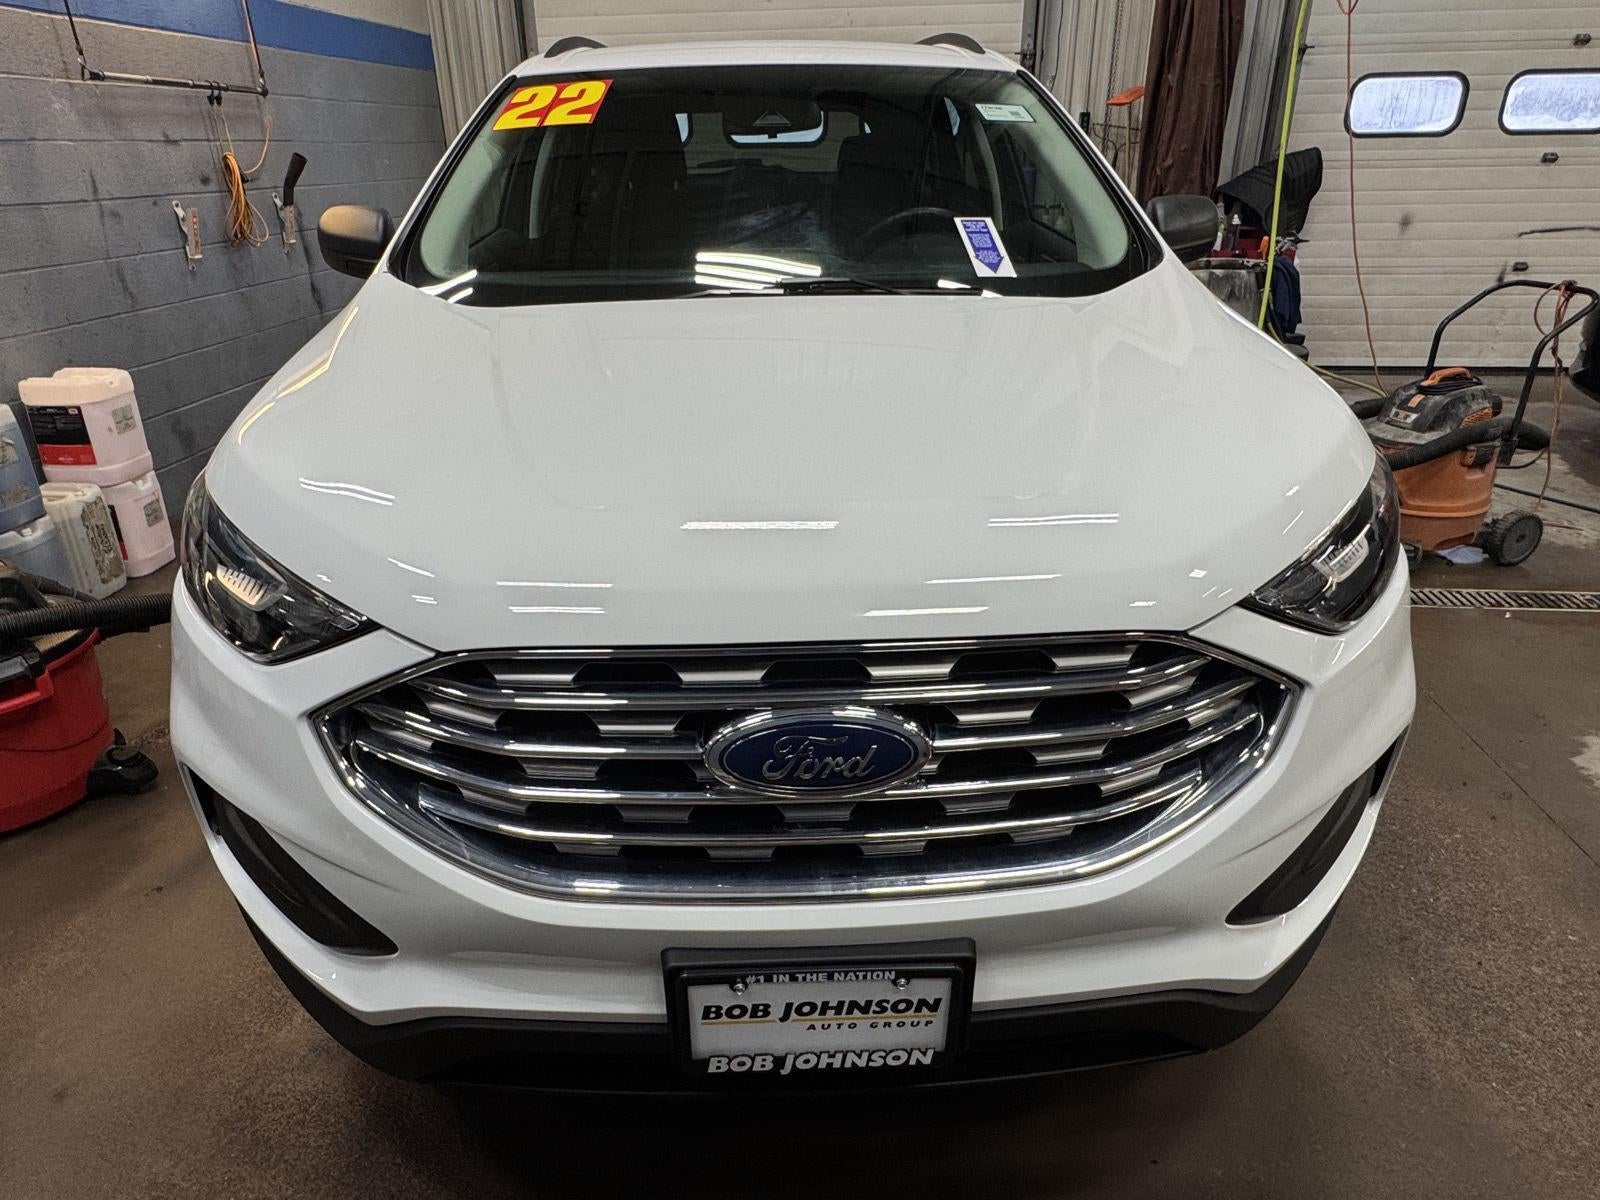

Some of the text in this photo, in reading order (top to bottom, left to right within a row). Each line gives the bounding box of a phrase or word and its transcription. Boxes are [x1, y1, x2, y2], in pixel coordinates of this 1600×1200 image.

[493, 81, 606, 131] 22
[762, 735, 878, 780] Ford
[746, 970, 896, 984] #1 IN THE NATION
[701, 998, 943, 1022] BOB JOHNSON
[806, 1020, 934, 1031] AUTO GROUP
[707, 1048, 935, 1075] BOB JOHNSON
